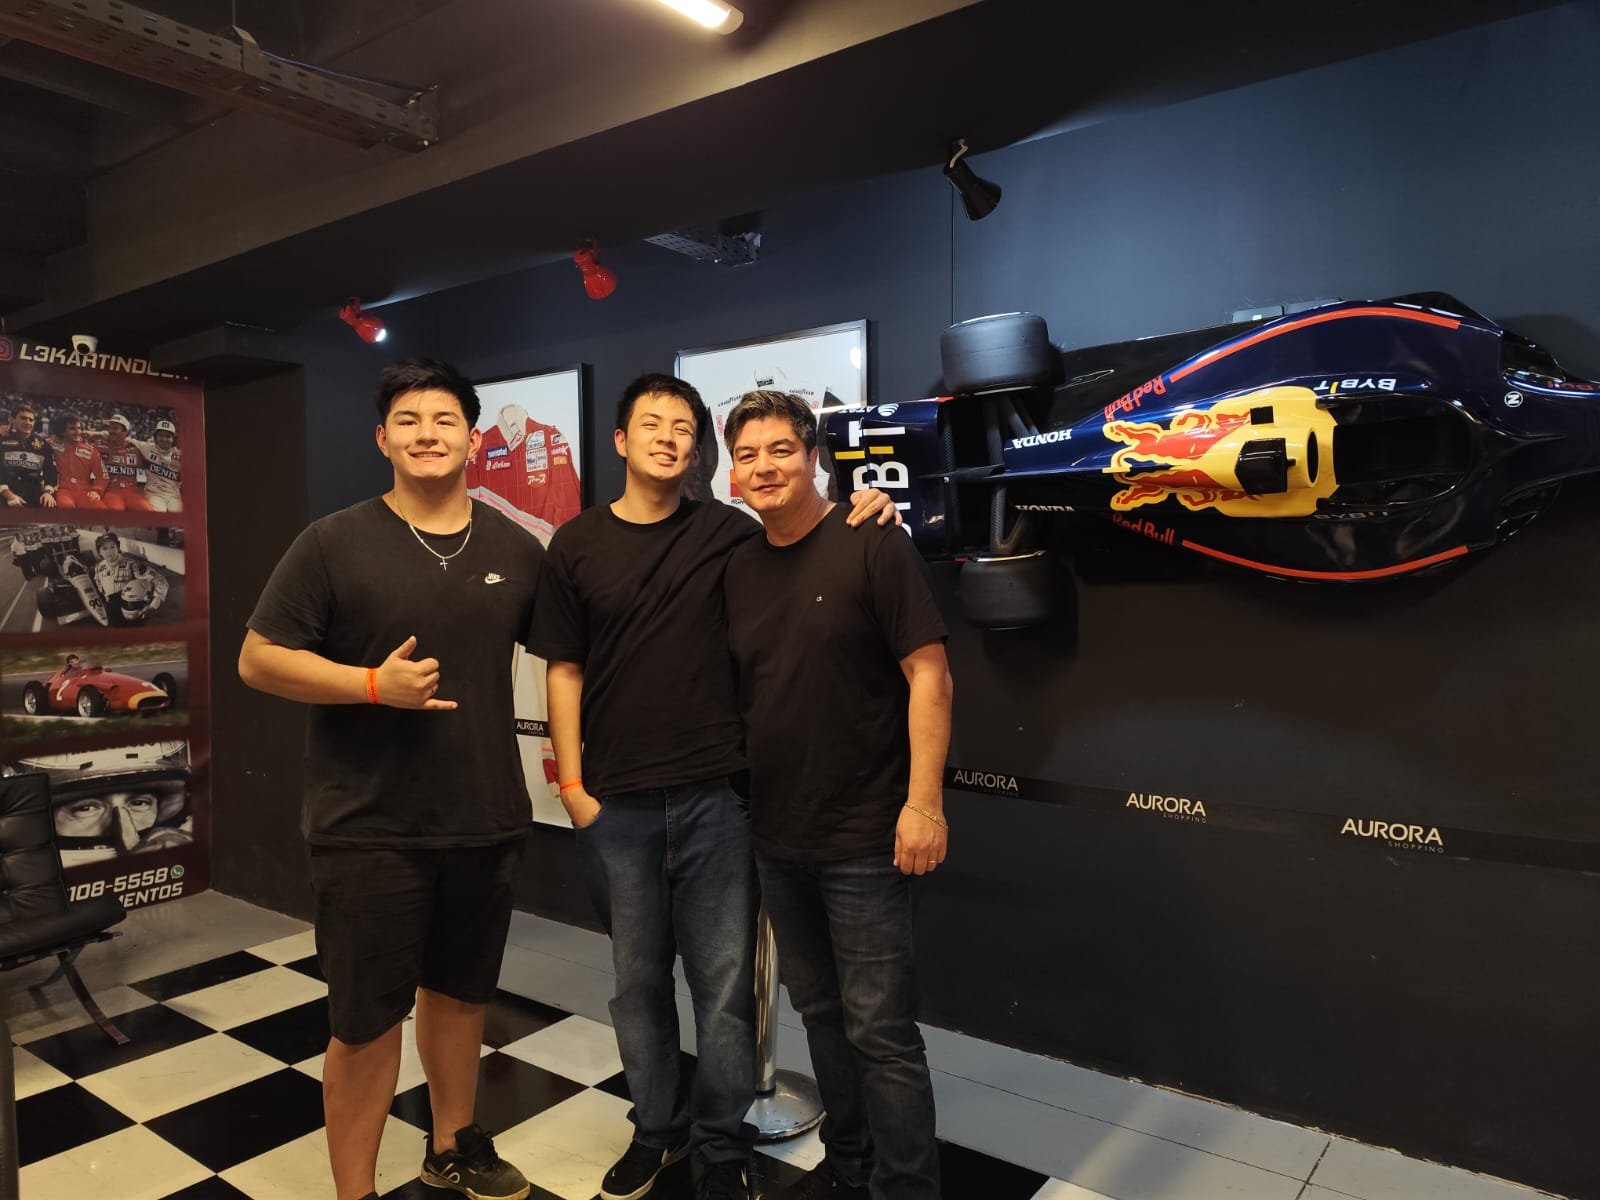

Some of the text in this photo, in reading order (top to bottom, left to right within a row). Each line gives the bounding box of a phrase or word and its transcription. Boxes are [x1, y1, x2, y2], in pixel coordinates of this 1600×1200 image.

[19, 343, 189, 381] L3KARTIND
[1104, 374, 1166, 422] Red Bull
[1313, 378, 1397, 394] BYBIT
[1011, 428, 1073, 450] HONDA
[835, 420, 912, 539] BIT
[1144, 521, 1176, 545] Bull
[516, 721, 544, 732] AURORA
[953, 768, 1019, 791] AURORA
[1126, 792, 1207, 817] AURORA
[1163, 813, 1208, 824] SHOPPING
[1340, 818, 1444, 846] AURORA
[1387, 841, 1445, 854] SHOPPING
[118, 882, 184, 909] ENTOS
